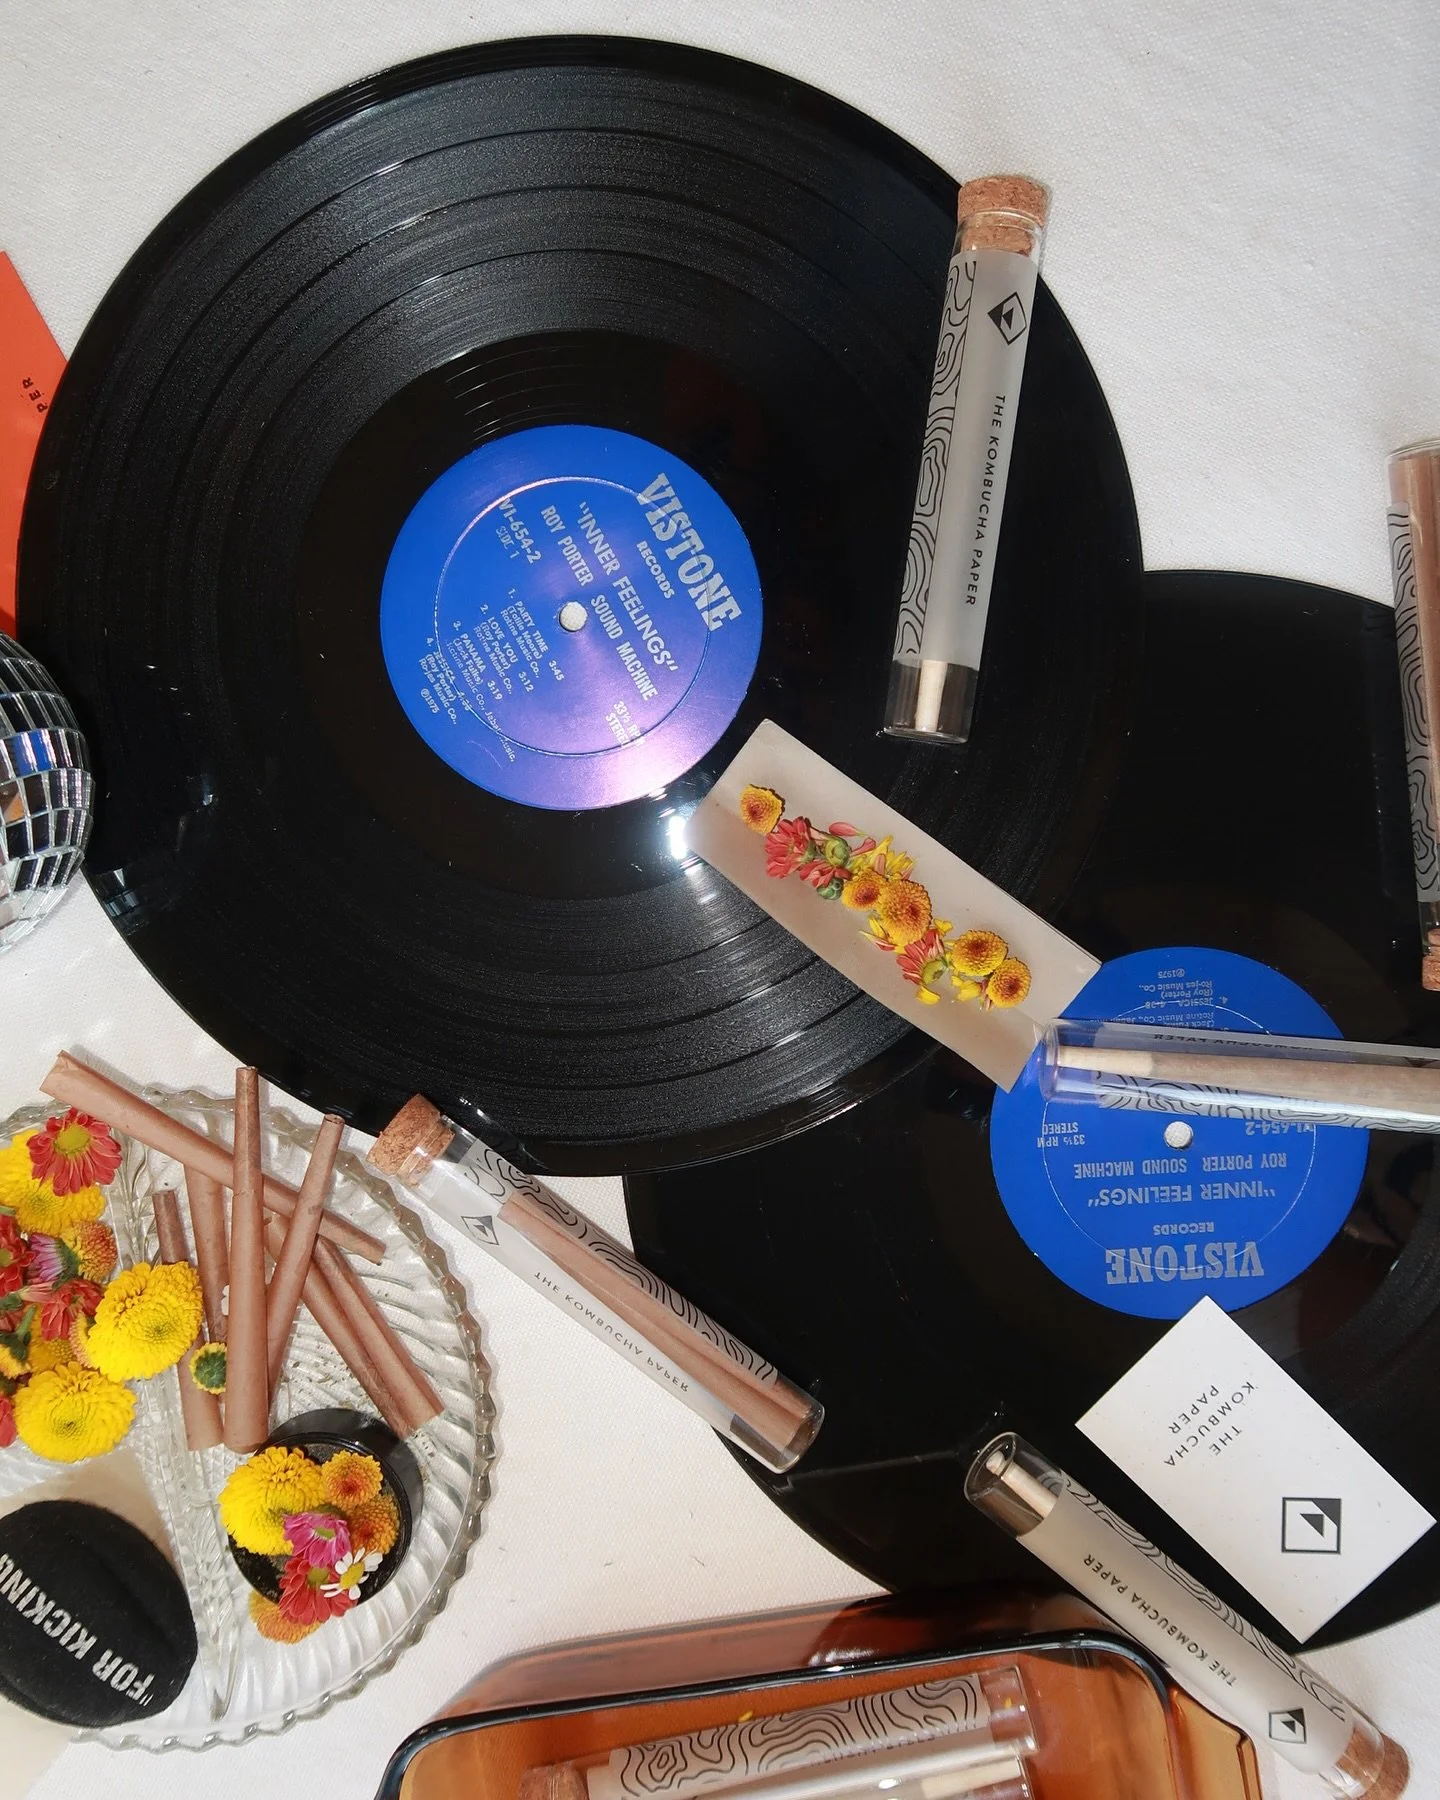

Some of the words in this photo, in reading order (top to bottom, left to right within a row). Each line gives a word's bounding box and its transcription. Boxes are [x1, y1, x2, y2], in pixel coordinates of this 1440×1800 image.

[991, 395, 1006, 429] THE
[975, 435, 1000, 540] KOMBUCHA
[496, 496, 543, 564] VI-654-2
[629, 471, 744, 632] VISTONE
[634, 539, 676, 599] RECORDS
[965, 548, 983, 606] PAPER
[539, 502, 565, 532] ROY
[556, 534, 595, 586] PORTER
[588, 592, 625, 641] SOUND
[614, 640, 659, 701] MACHINE
[486, 616, 505, 640] LOVE
[501, 641, 518, 664] YOU
[517, 670, 534, 692] 3:12
[490, 640, 512, 670] Porter)
[514, 600, 535, 628] PARTY
[531, 629, 549, 652] TIME
[547, 658, 565, 681] 3:45
[515, 635, 534, 661] Music
[459, 632, 487, 673] PANAMA
[486, 679, 503, 701] 3:19
[487, 652, 507, 678] Music
[432, 682, 451, 708] Music
[435, 672, 457, 702] Porter)
[460, 668, 479, 694] Music
[1157, 982, 1183, 991] Music
[1160, 988, 1191, 999] Porter)
[1193, 987, 1213, 997] (Roy
[1157, 1013, 1183, 1022] Music
[1036, 1135, 1059, 1147] RPM
[1041, 1121, 1078, 1134] STEREO
[1073, 1159, 1134, 1179] MACHINE
[1142, 1156, 1187, 1175] SOUND
[1201, 1153, 1252, 1172] PORTER
[1259, 1152, 1287, 1168] ROY
[1152, 1221, 1214, 1235] RECORDS
[1104, 1239, 1264, 1285] VISTONE
[1163, 1381, 1255, 1466] KOMBUCHA
[1168, 1384, 1219, 1434] PAPER
[1208, 1425, 1243, 1456] THE
[1083, 1554, 1128, 1595] PAPER
[1131, 1592, 1208, 1662] KOMBUCHA
[1208, 1659, 1238, 1687] THE
